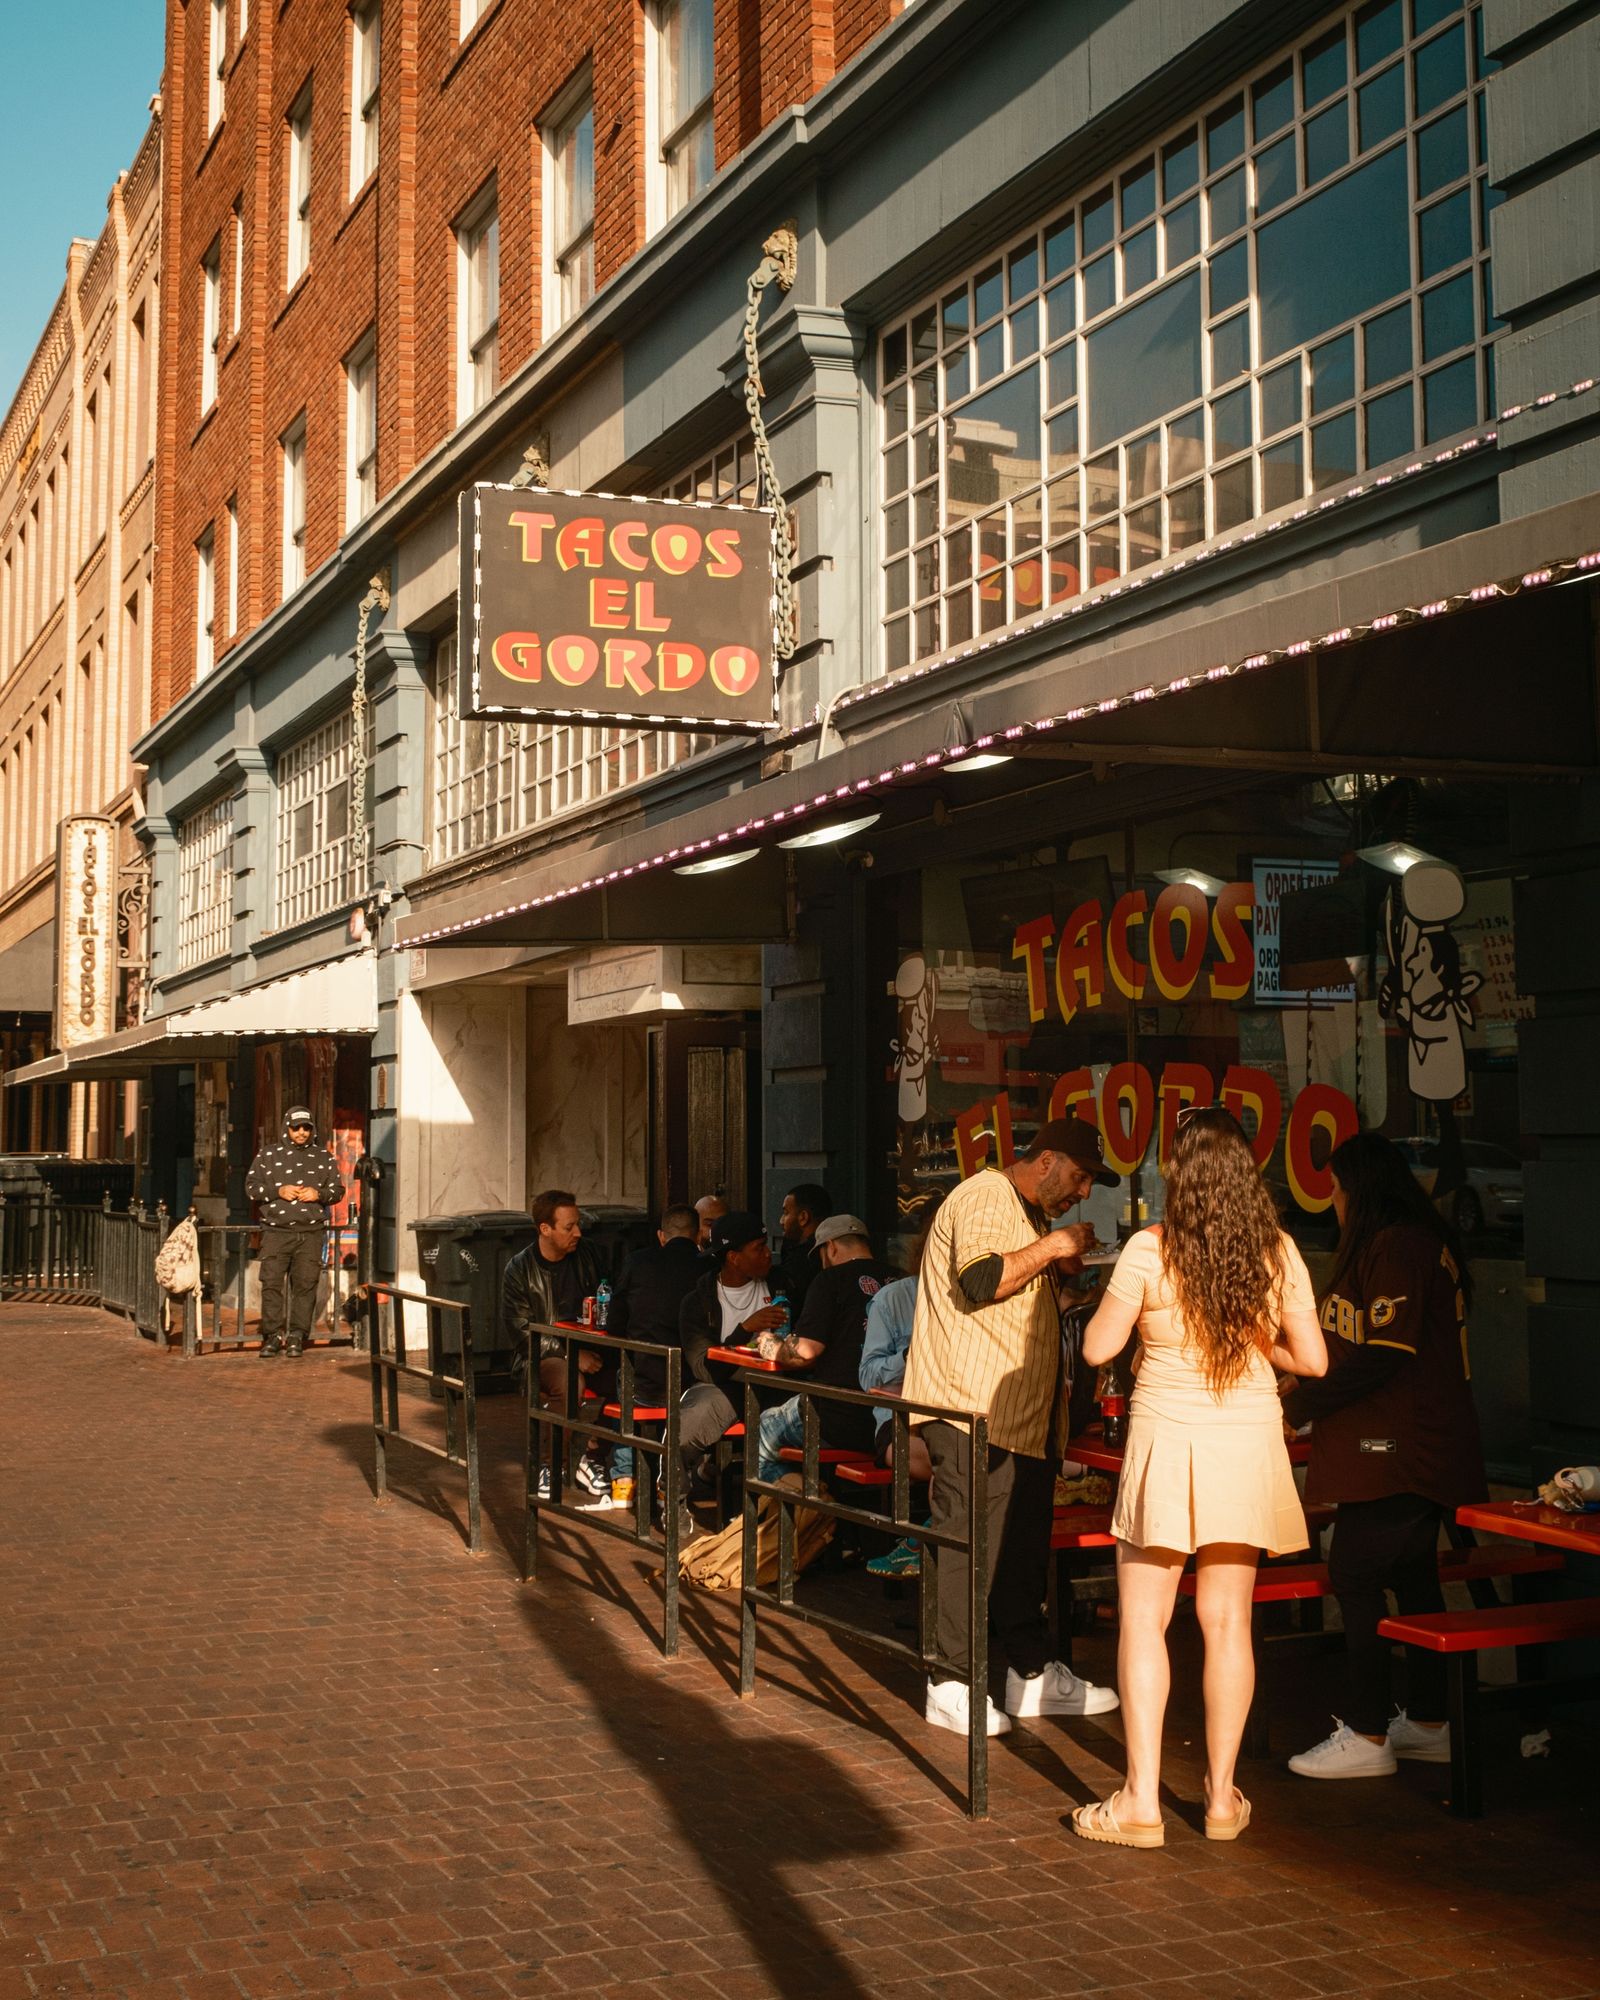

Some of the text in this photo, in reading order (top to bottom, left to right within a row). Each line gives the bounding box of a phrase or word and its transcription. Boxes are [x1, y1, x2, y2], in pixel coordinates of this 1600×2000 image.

[509, 511, 743, 578] TACOS
[590, 578, 672, 632] EL
[491, 631, 760, 697] GORDO
[77, 828, 99, 1028] TACOS EL GORDO
[1012, 882, 1256, 1025] TACOS
[1488, 953, 1515, 967] $3.9
[1257, 970, 1281, 991] PAG
[953, 1091, 1015, 1182] EL
